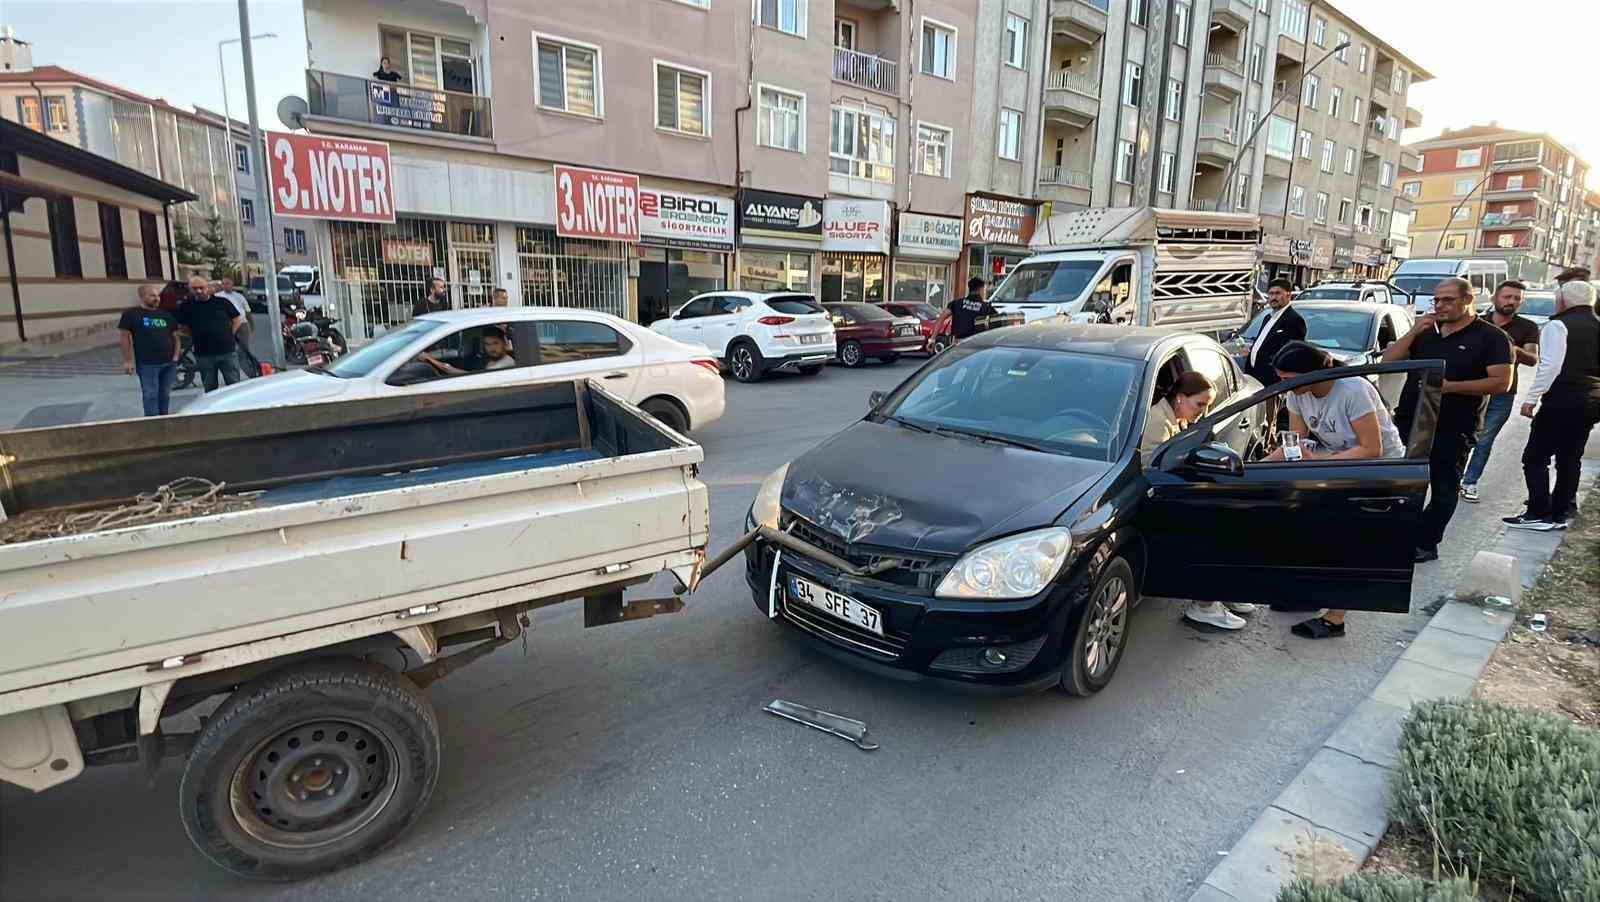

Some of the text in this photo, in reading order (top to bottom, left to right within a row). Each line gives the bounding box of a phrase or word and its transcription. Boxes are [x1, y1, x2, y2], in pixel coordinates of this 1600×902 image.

[661, 208, 728, 225] ERDEMSOY
[745, 203, 800, 220] ALYANS
[823, 221, 880, 232] ULUER
[387, 243, 433, 261] NOTER
[797, 582, 877, 629] 34 SFE 37
